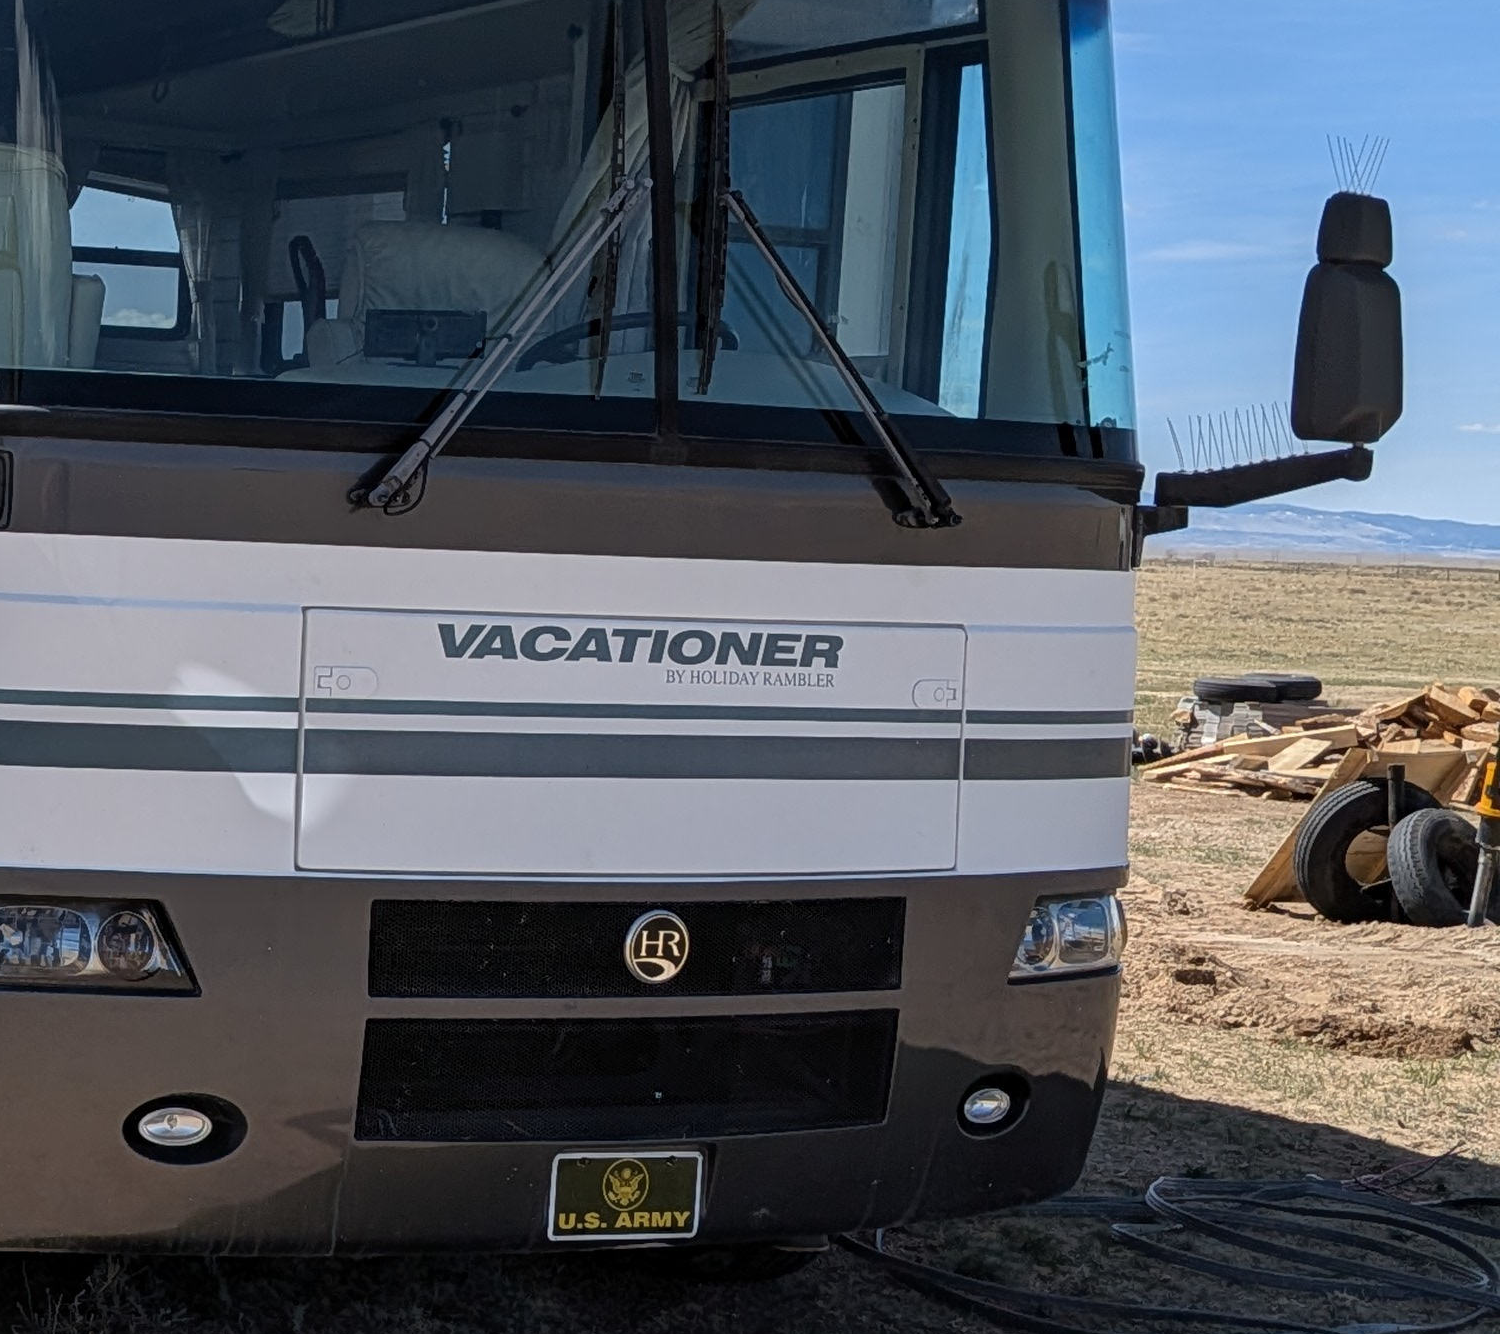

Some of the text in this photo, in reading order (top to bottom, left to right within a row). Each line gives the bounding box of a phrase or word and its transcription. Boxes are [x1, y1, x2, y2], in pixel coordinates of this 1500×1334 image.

[437, 622, 844, 669] VACATIONER
[665, 669, 836, 688] BY HOLIDAY RAMBLER
[639, 929, 681, 958] HR
[558, 1210, 691, 1230] U.S. ARMY
